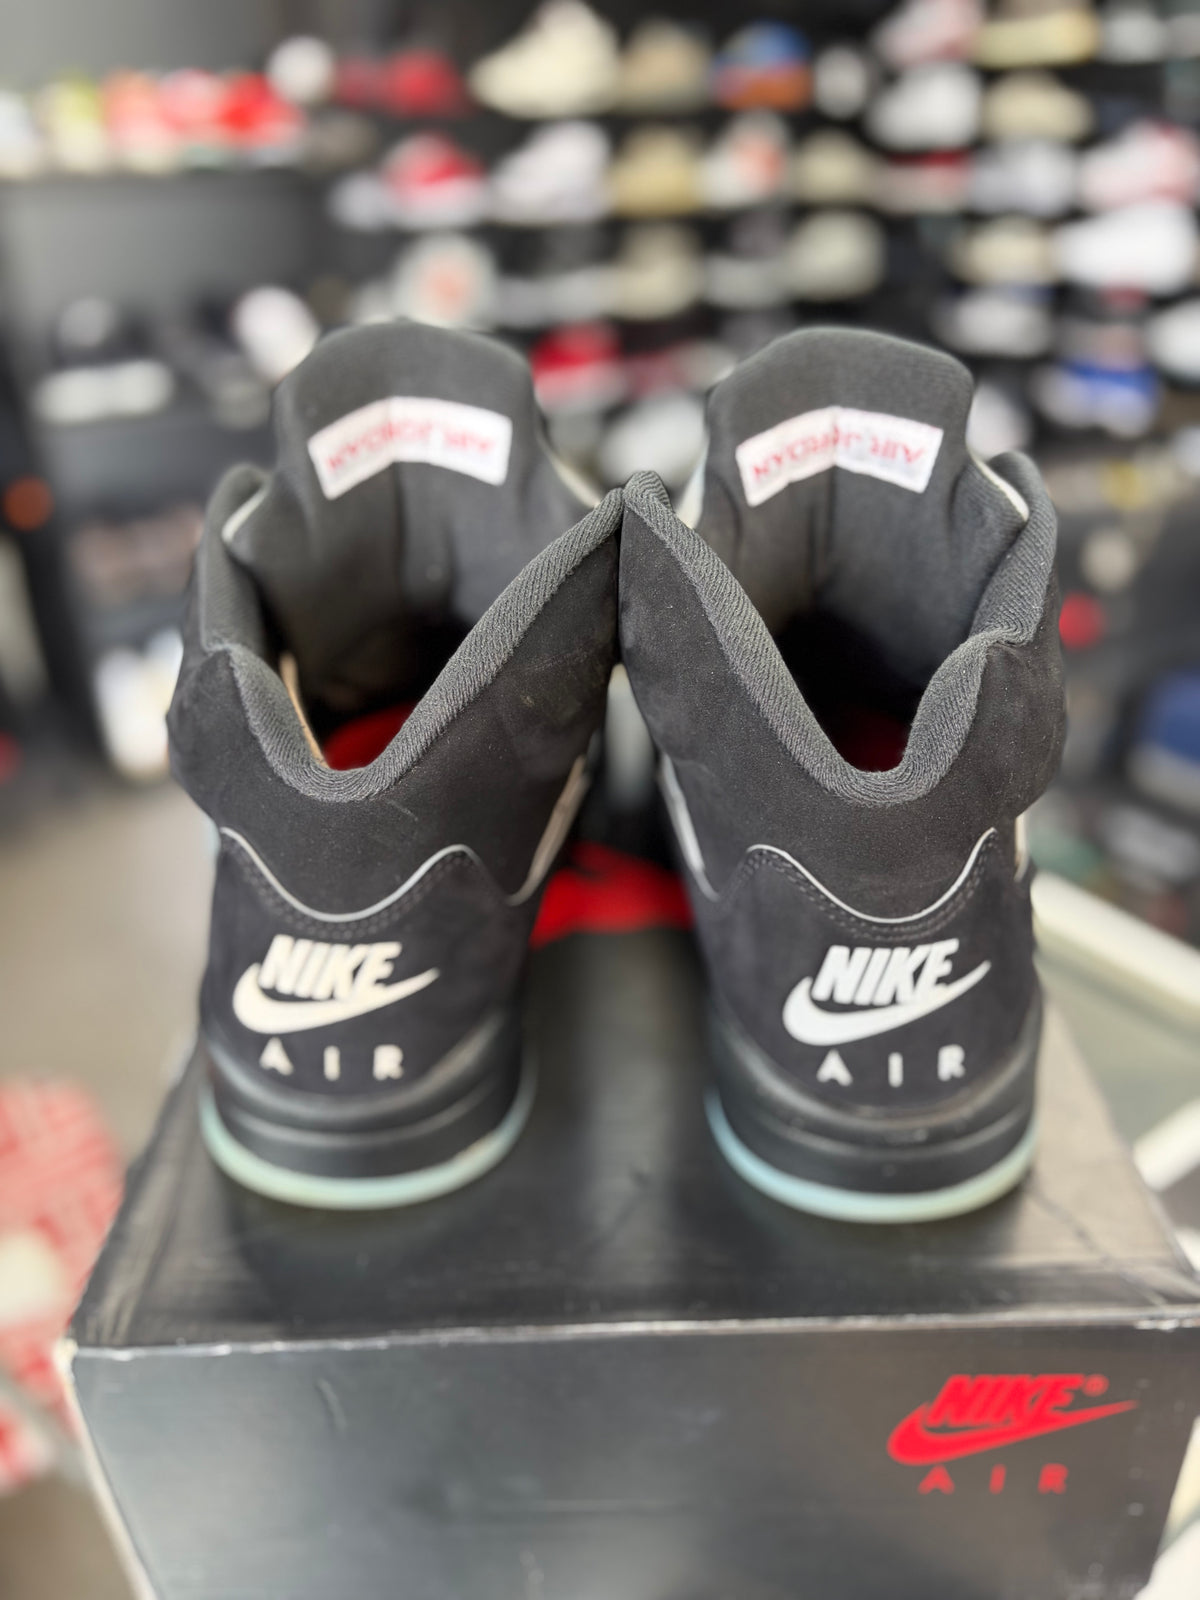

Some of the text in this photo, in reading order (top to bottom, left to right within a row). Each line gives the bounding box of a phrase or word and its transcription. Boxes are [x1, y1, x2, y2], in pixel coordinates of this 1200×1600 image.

[258, 934, 402, 1001] NIKE
[811, 938, 960, 1006] NIKE
[259, 1037, 404, 1081] AIR
[816, 1044, 965, 1088] AIR
[917, 1463, 1069, 1495] AIR
